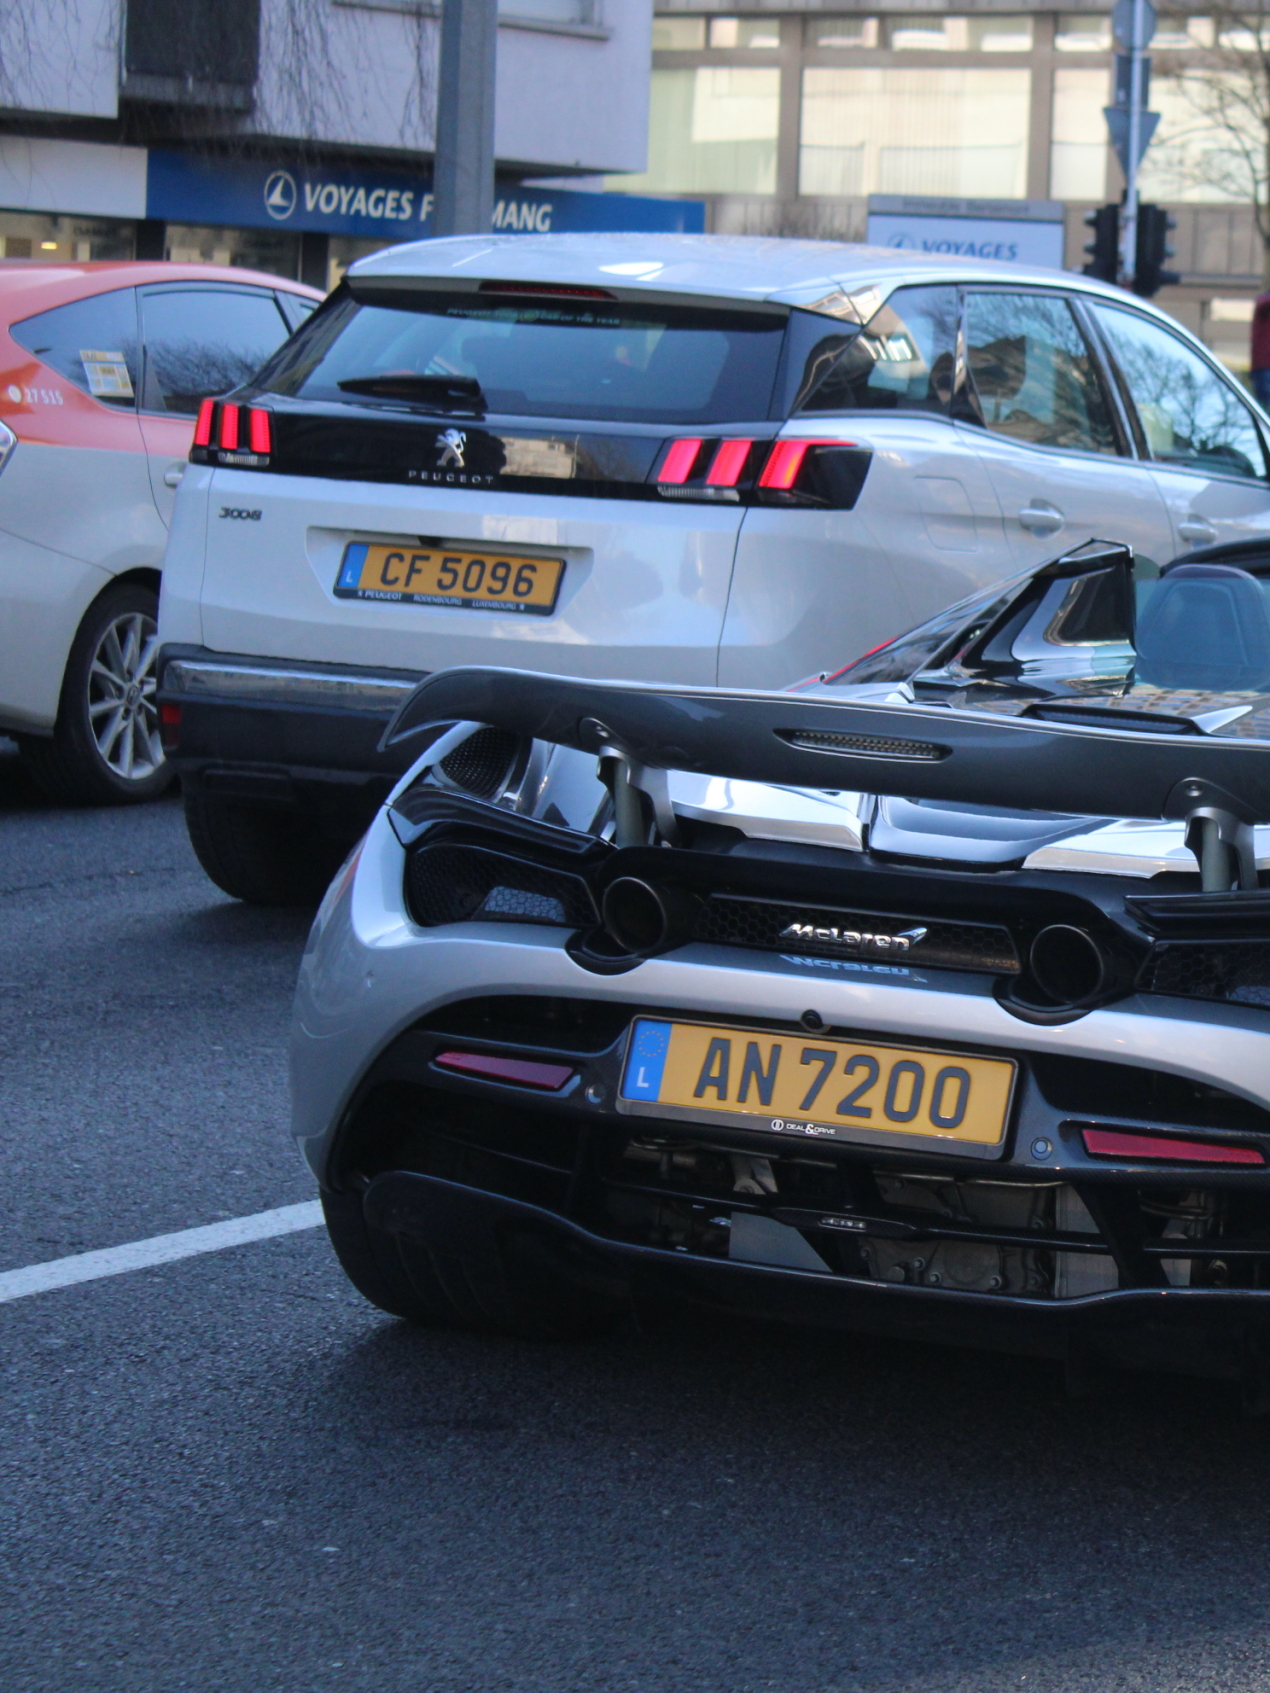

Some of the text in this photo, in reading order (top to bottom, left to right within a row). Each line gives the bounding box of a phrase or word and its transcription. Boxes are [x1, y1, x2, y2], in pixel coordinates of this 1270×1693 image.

[304, 182, 553, 232] VOYAGES FMANG
[922, 240, 1018, 261] VOYAGES
[408, 470, 494, 485] PEUGEOT
[219, 507, 262, 521] 3008
[380, 553, 430, 588] CF
[437, 557, 538, 597] 5096
[364, 591, 402, 601] PEUGEOT
[779, 923, 910, 950] McLaren
[636, 1036, 971, 1129] L AN 7200
